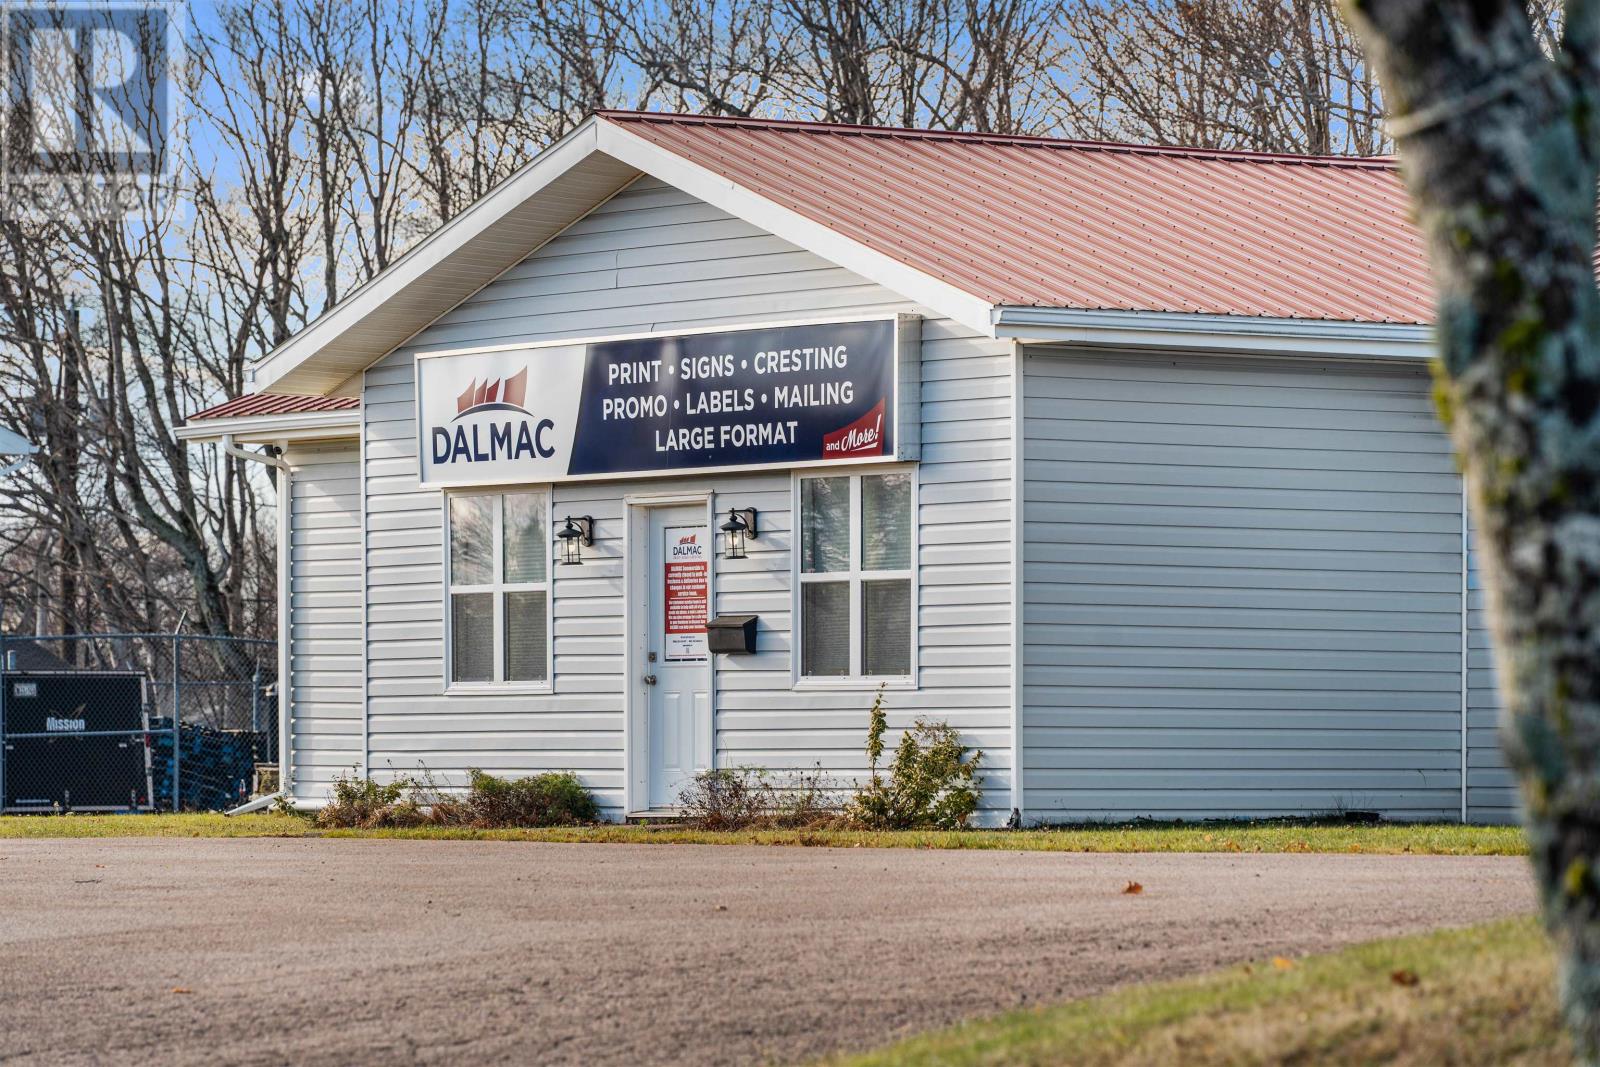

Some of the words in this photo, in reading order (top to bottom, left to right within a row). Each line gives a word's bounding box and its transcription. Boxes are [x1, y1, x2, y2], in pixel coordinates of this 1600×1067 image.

[608, 362, 662, 386] PRINT
[681, 354, 735, 380] SIGNS
[754, 345, 848, 374] CRESTING
[602, 395, 668, 421] PROMO
[686, 389, 754, 414] LABELS
[774, 381, 854, 407] MAILING
[432, 419, 556, 465] DALMAC
[655, 426, 714, 453] LARGE
[720, 421, 798, 448] FORMAT
[826, 440, 840, 451] and
[841, 413, 882, 452] More!
[672, 545, 702, 556] DALMAC
[46, 717, 85, 731] Mission
